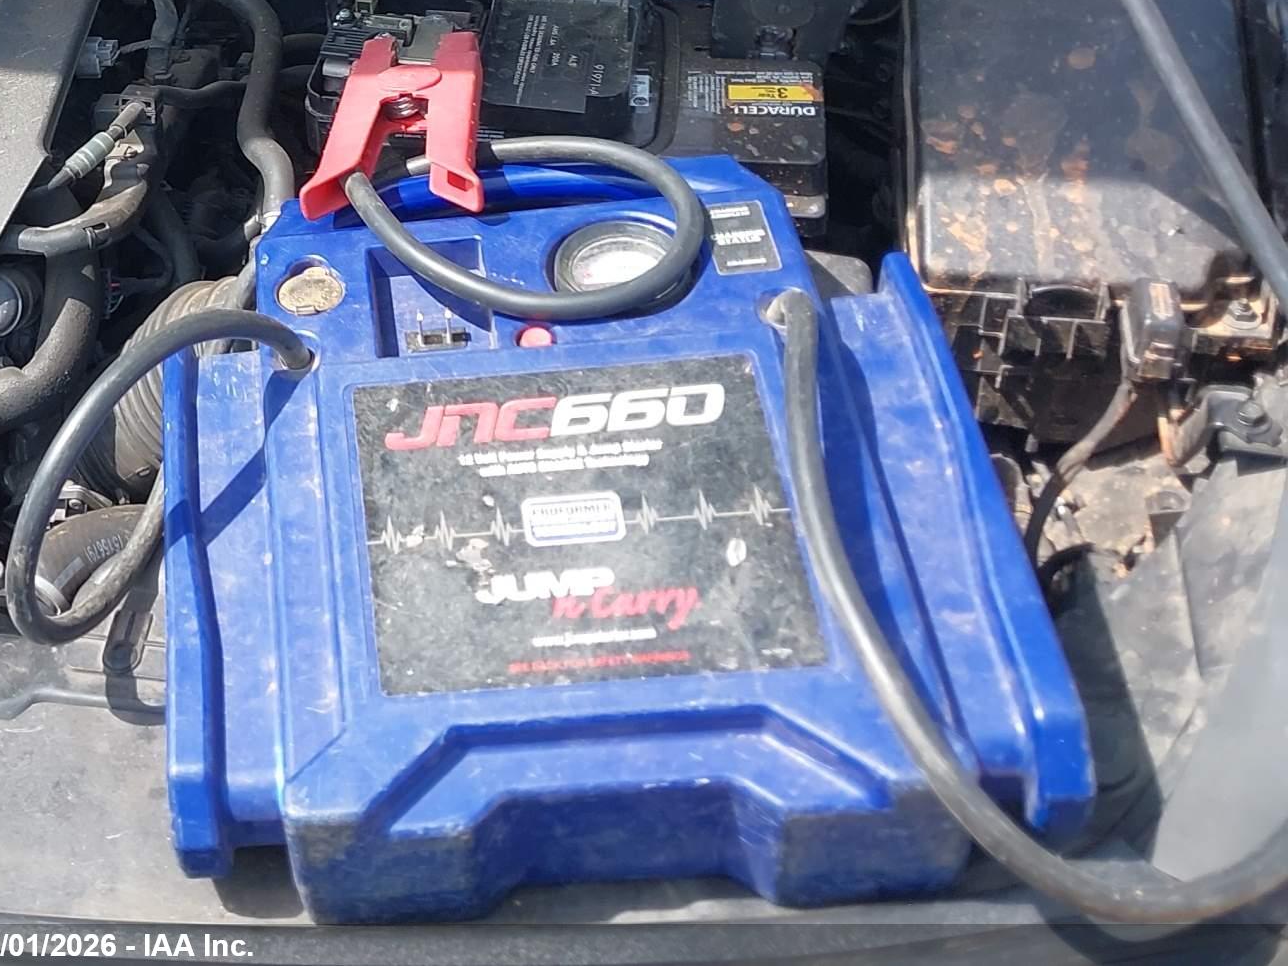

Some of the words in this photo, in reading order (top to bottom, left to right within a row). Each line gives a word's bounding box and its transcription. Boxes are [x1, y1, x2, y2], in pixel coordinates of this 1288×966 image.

[777, 87, 788, 99] 3
[732, 105, 816, 116] DURACELL
[475, 567, 615, 605] JUMP
